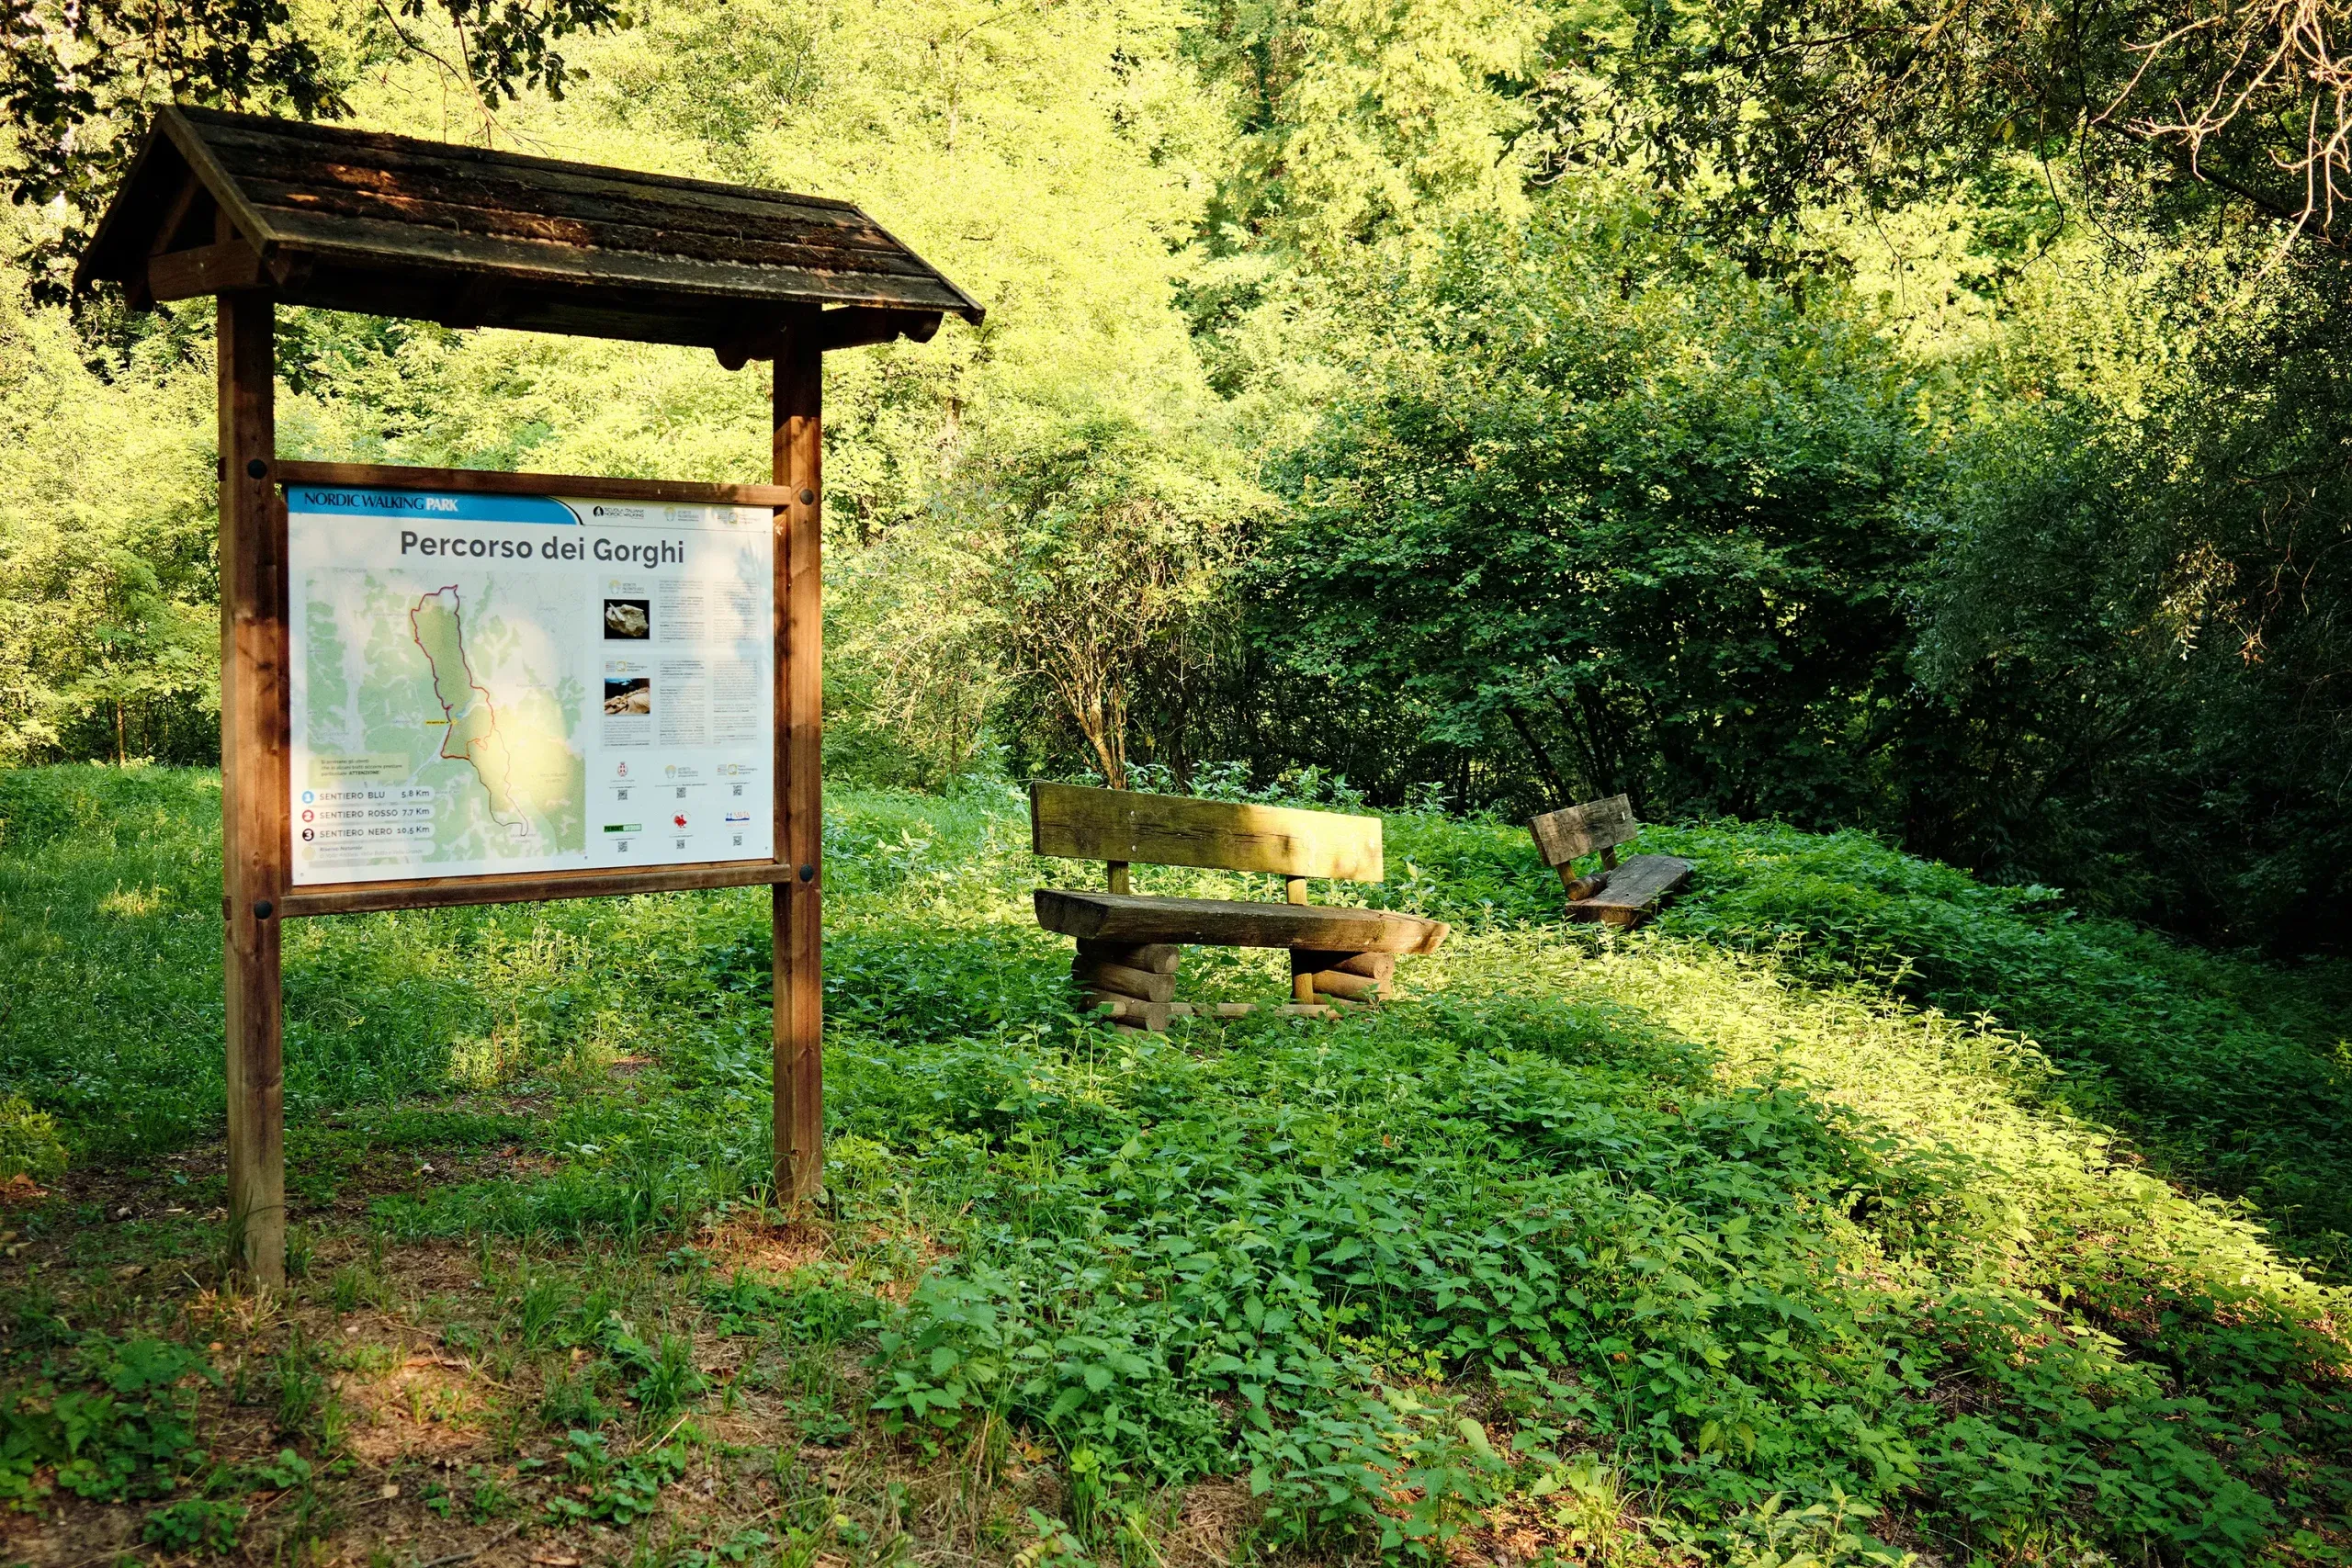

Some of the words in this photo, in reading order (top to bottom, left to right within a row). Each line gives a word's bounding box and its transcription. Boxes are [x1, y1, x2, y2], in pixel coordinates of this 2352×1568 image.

[304, 492, 360, 507] NORDIC
[360, 494, 424, 510] WALKING
[425, 497, 458, 512] PARK
[401, 530, 533, 558] Percorso
[541, 536, 584, 559] dei
[593, 537, 684, 569] Gorghi
[320, 792, 364, 801] SENTIERO
[368, 791, 385, 799] BLU
[416, 789, 430, 797] Km
[320, 810, 364, 819] SENTIERO
[368, 808, 398, 818] ROSSO
[402, 808, 413, 817] 7.7
[416, 807, 430, 816] Km
[305, 830, 312, 840] 3
[320, 829, 364, 838] SENTIERO
[368, 828, 392, 836] NERO
